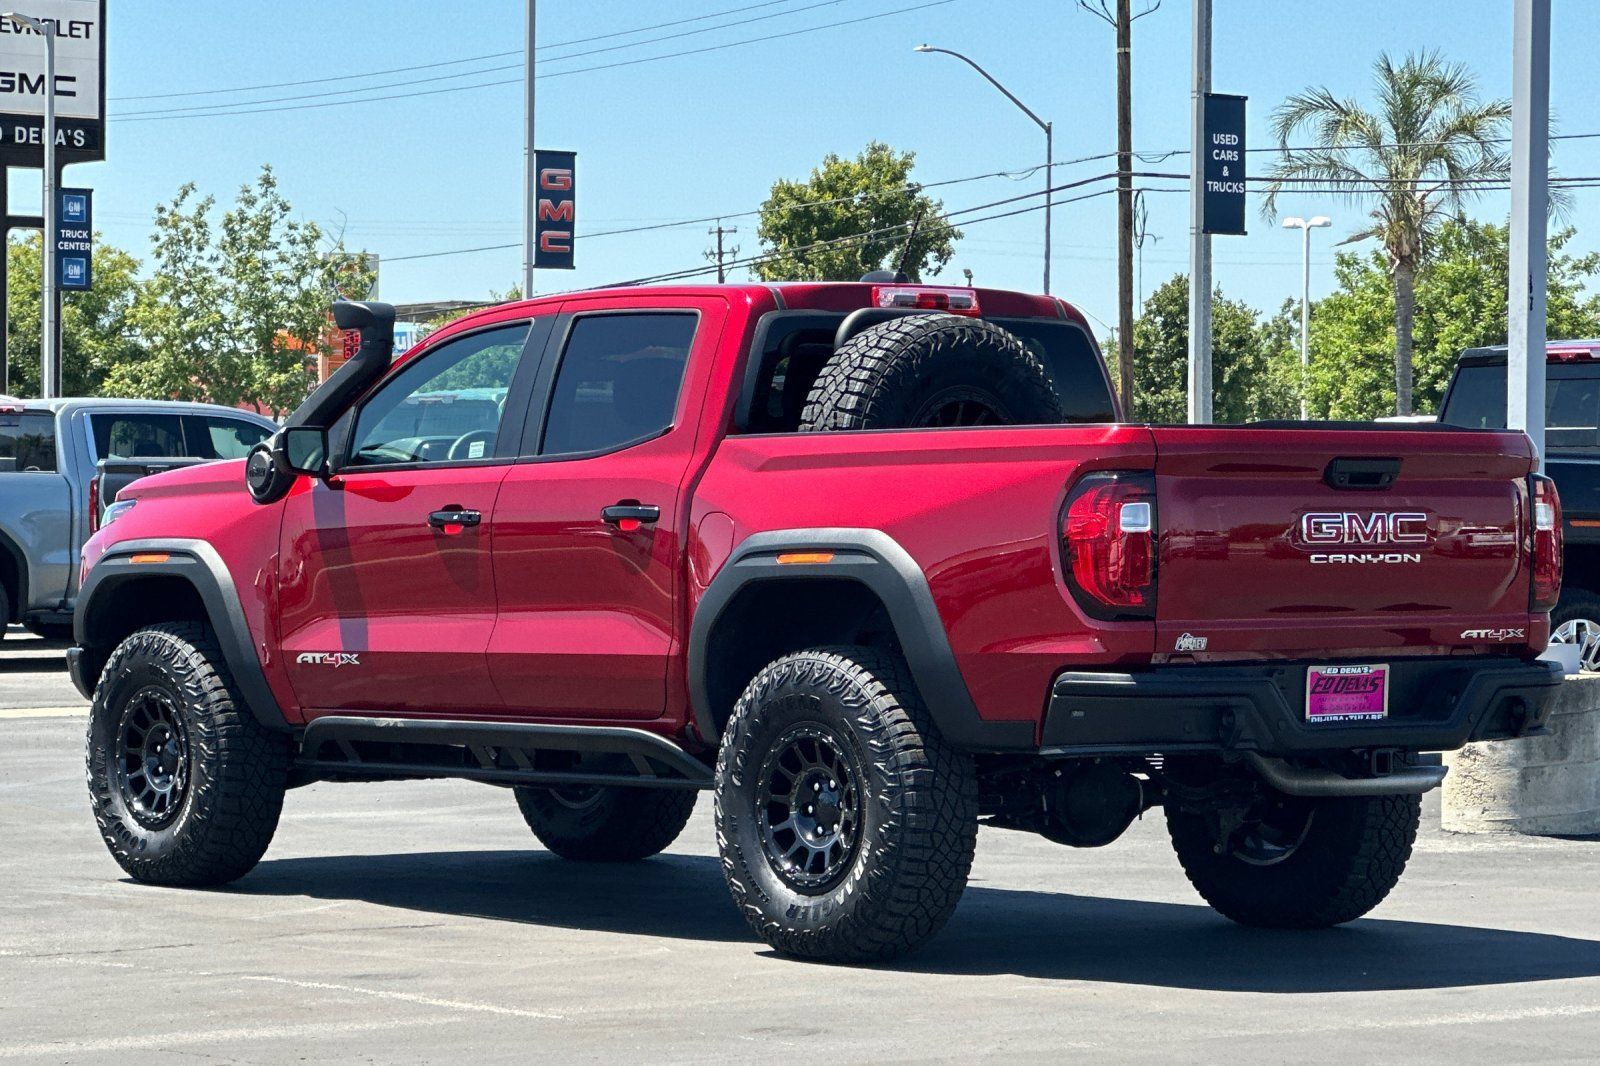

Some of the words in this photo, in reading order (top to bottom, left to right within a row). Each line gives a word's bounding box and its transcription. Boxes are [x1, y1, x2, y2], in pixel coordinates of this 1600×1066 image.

[14, 126, 85, 147] DEA'S
[1212, 133, 1238, 145] USED
[1212, 149, 1239, 161] CARS
[1222, 166, 1229, 177] &
[1206, 181, 1245, 194] TRUCKS
[538, 168, 574, 253] GMC
[60, 229, 89, 239] TRUCK
[57, 241, 91, 251] CENTER
[1302, 512, 1427, 544] GMC
[1309, 553, 1421, 564] CANYON
[1460, 628, 1525, 642] AT4X
[296, 652, 360, 668] AT4X
[1340, 666, 1369, 674] DENA'S
